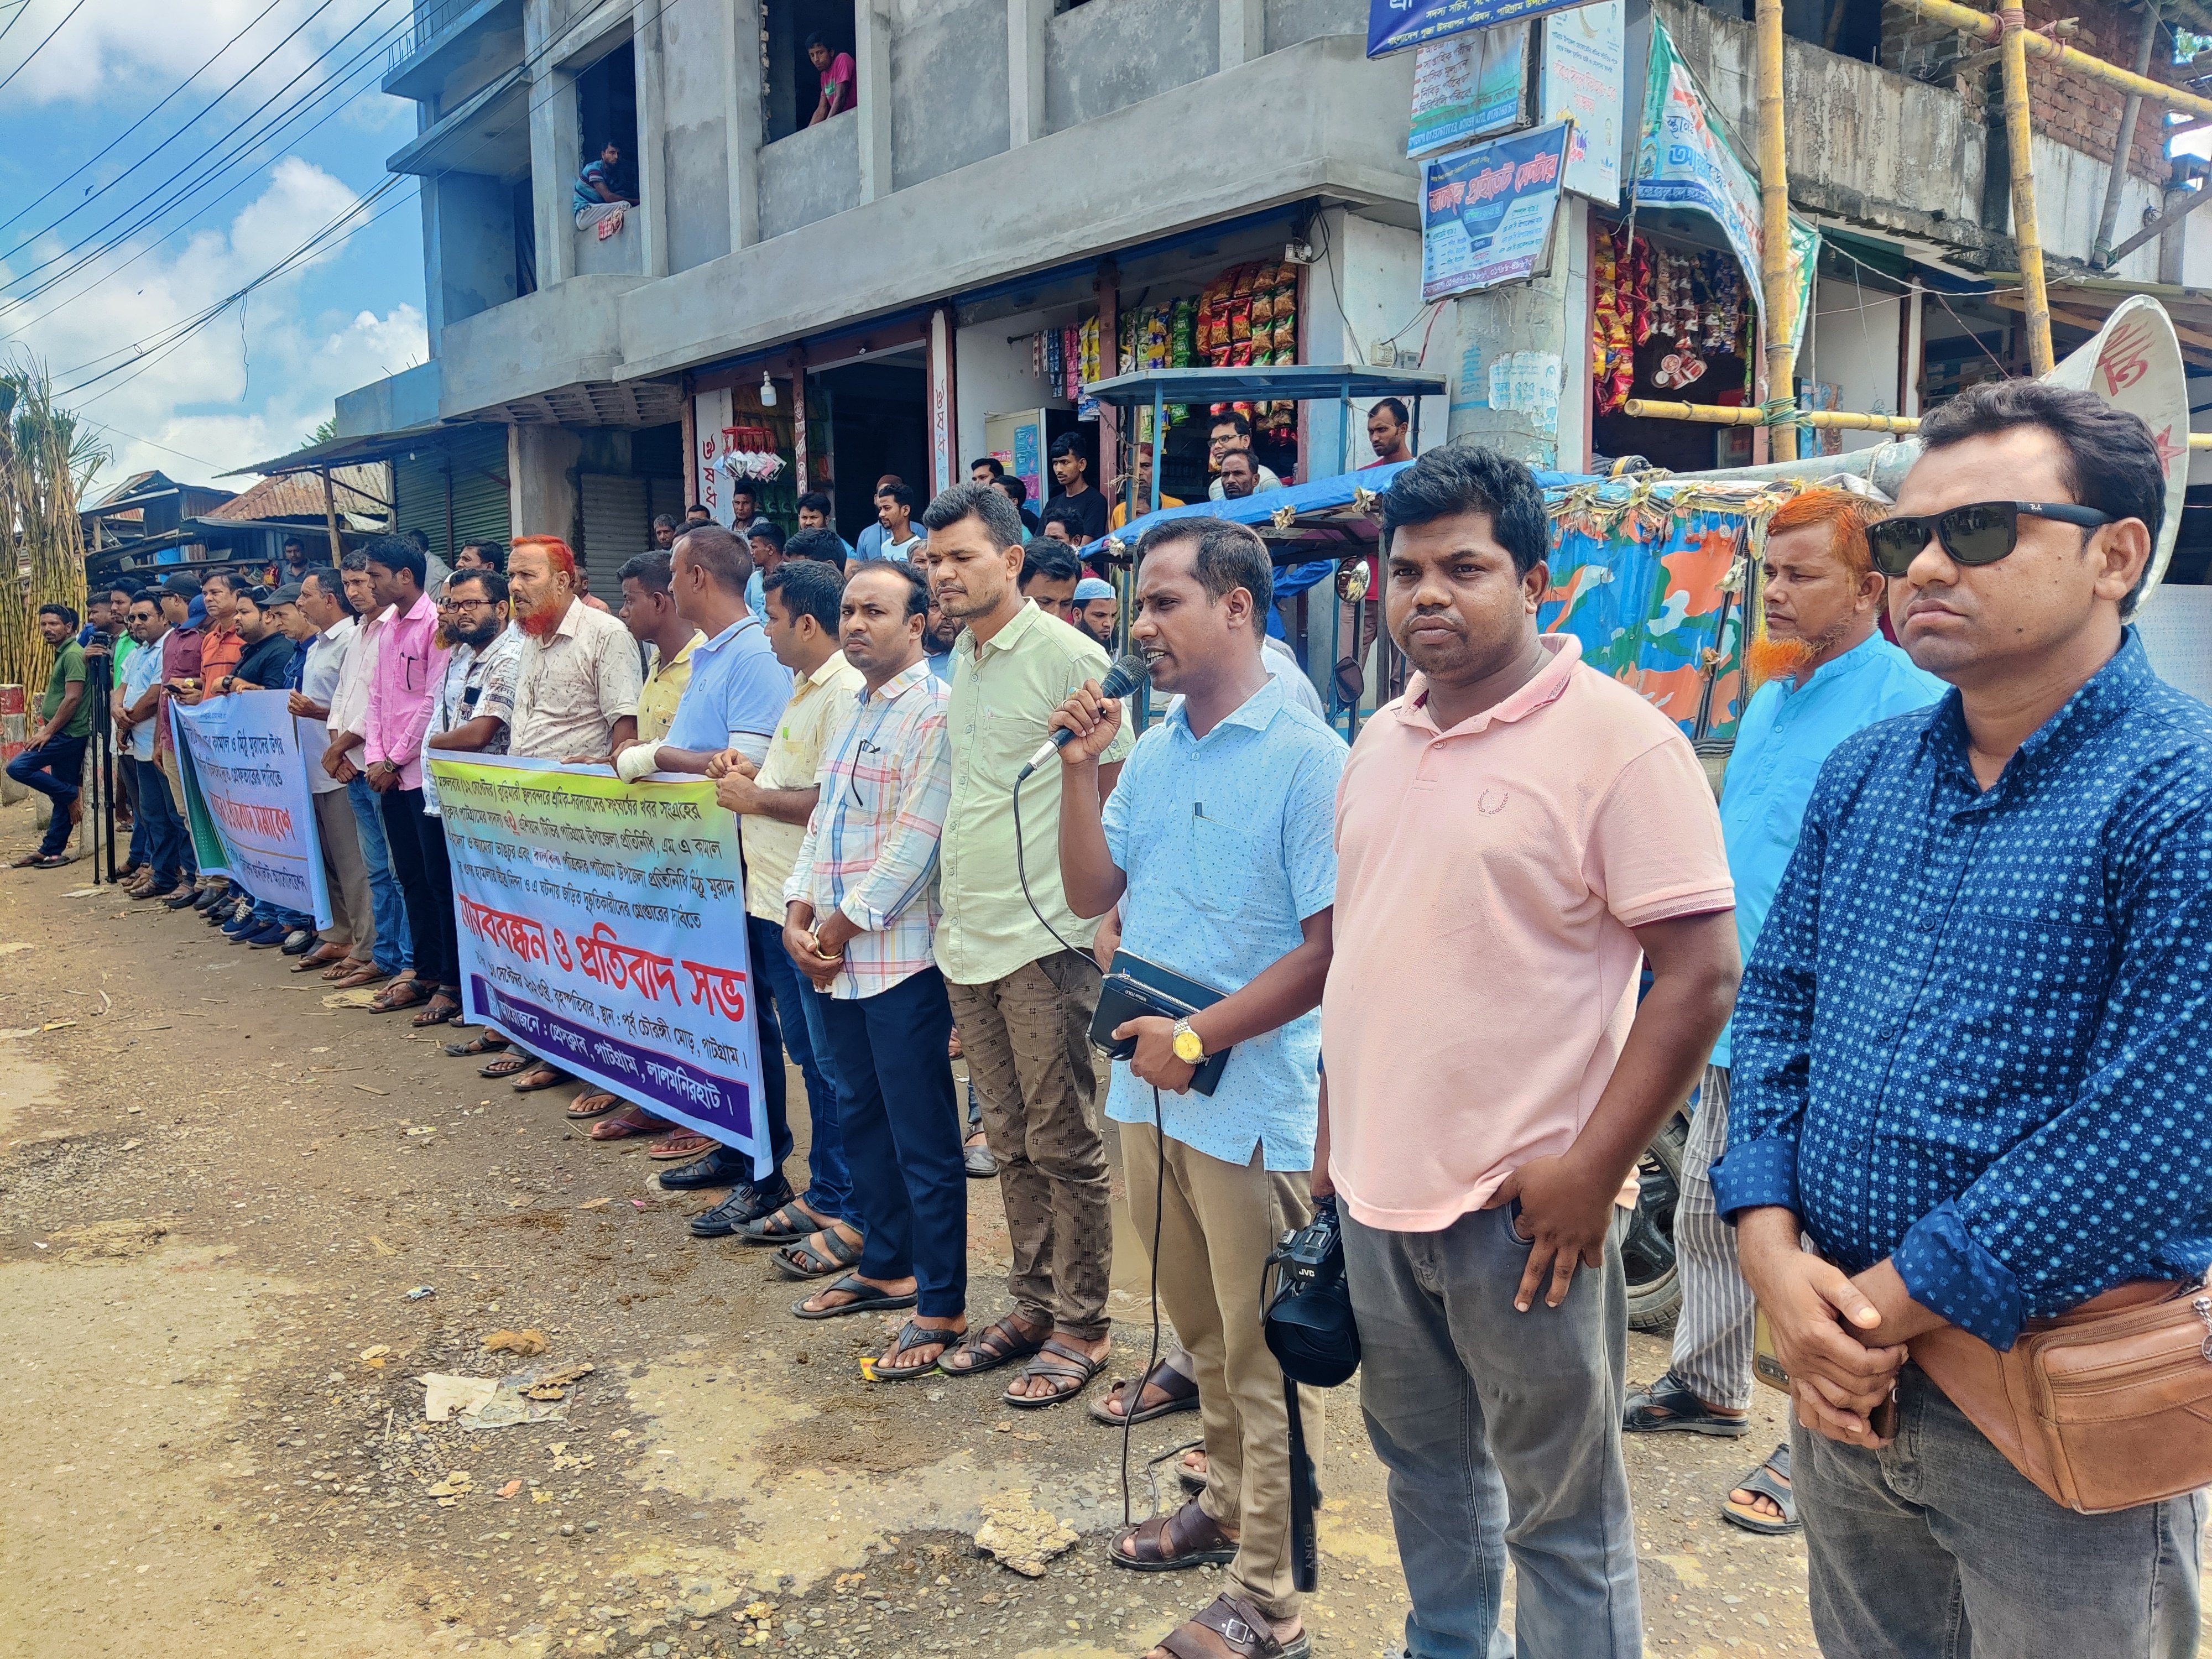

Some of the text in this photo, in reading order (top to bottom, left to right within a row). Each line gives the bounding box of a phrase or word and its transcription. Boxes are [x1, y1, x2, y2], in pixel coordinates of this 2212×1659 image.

[497, 780, 521, 803] বুড়িমারী
[521, 787, 551, 807] স্থলবন্দরে
[604, 793, 638, 817] সংঘর্ষের
[640, 797, 658, 820] খবর
[659, 800, 702, 821] সংগ্রহের
[560, 821, 587, 845] পাটগ্রাম
[585, 823, 620, 850] উপজেলা
[662, 837, 677, 857] এম
[678, 839, 692, 856] এ
[691, 837, 722, 859] কামাল
[517, 846, 533, 864] এবং
[590, 856, 616, 881] পাটগ্রাম
[615, 859, 647, 889] উপজেলা
[648, 867, 688, 893] প্রতিনিধি
[706, 877, 736, 902] মুরাদ
[562, 881, 582, 907] জড়িত
[670, 904, 701, 930] দাবিতে
[458, 893, 747, 1022] মানববন্ধন ও প্রতিবাদ সভ
[702, 1033, 740, 1067] পাটগ্রাম
[645, 1060, 722, 1110] লালমনিরহাট
[1298, 1268, 1316, 1277] JVC
